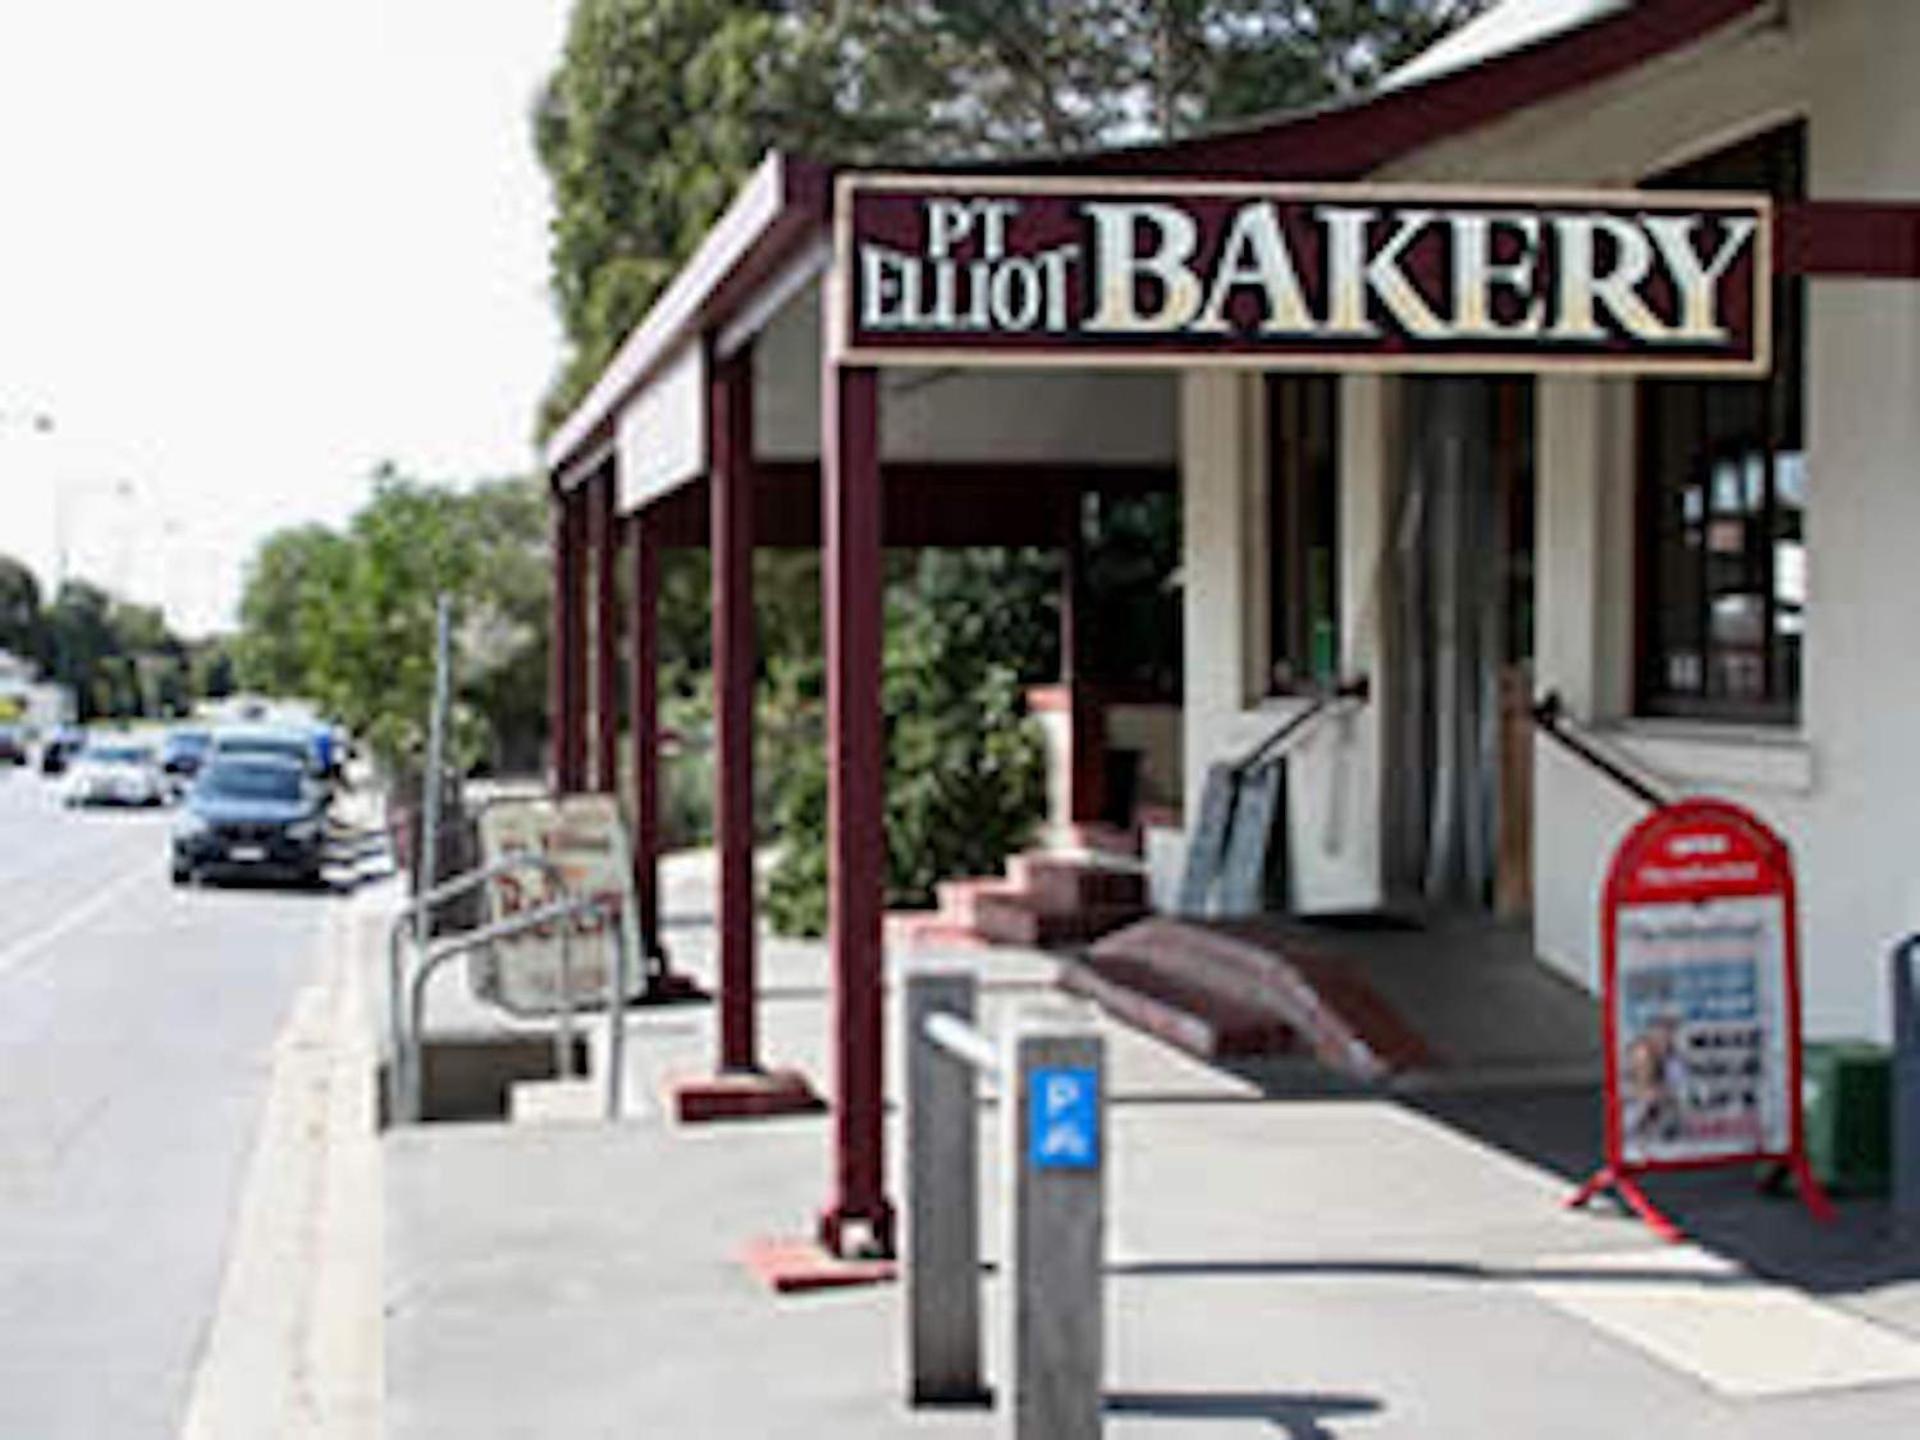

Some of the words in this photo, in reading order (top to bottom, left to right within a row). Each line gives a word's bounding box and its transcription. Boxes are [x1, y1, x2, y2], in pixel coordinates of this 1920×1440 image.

[926, 198, 1018, 259] PT
[1081, 200, 1757, 342] BAKERY
[860, 242, 1080, 332] ELLIOT
